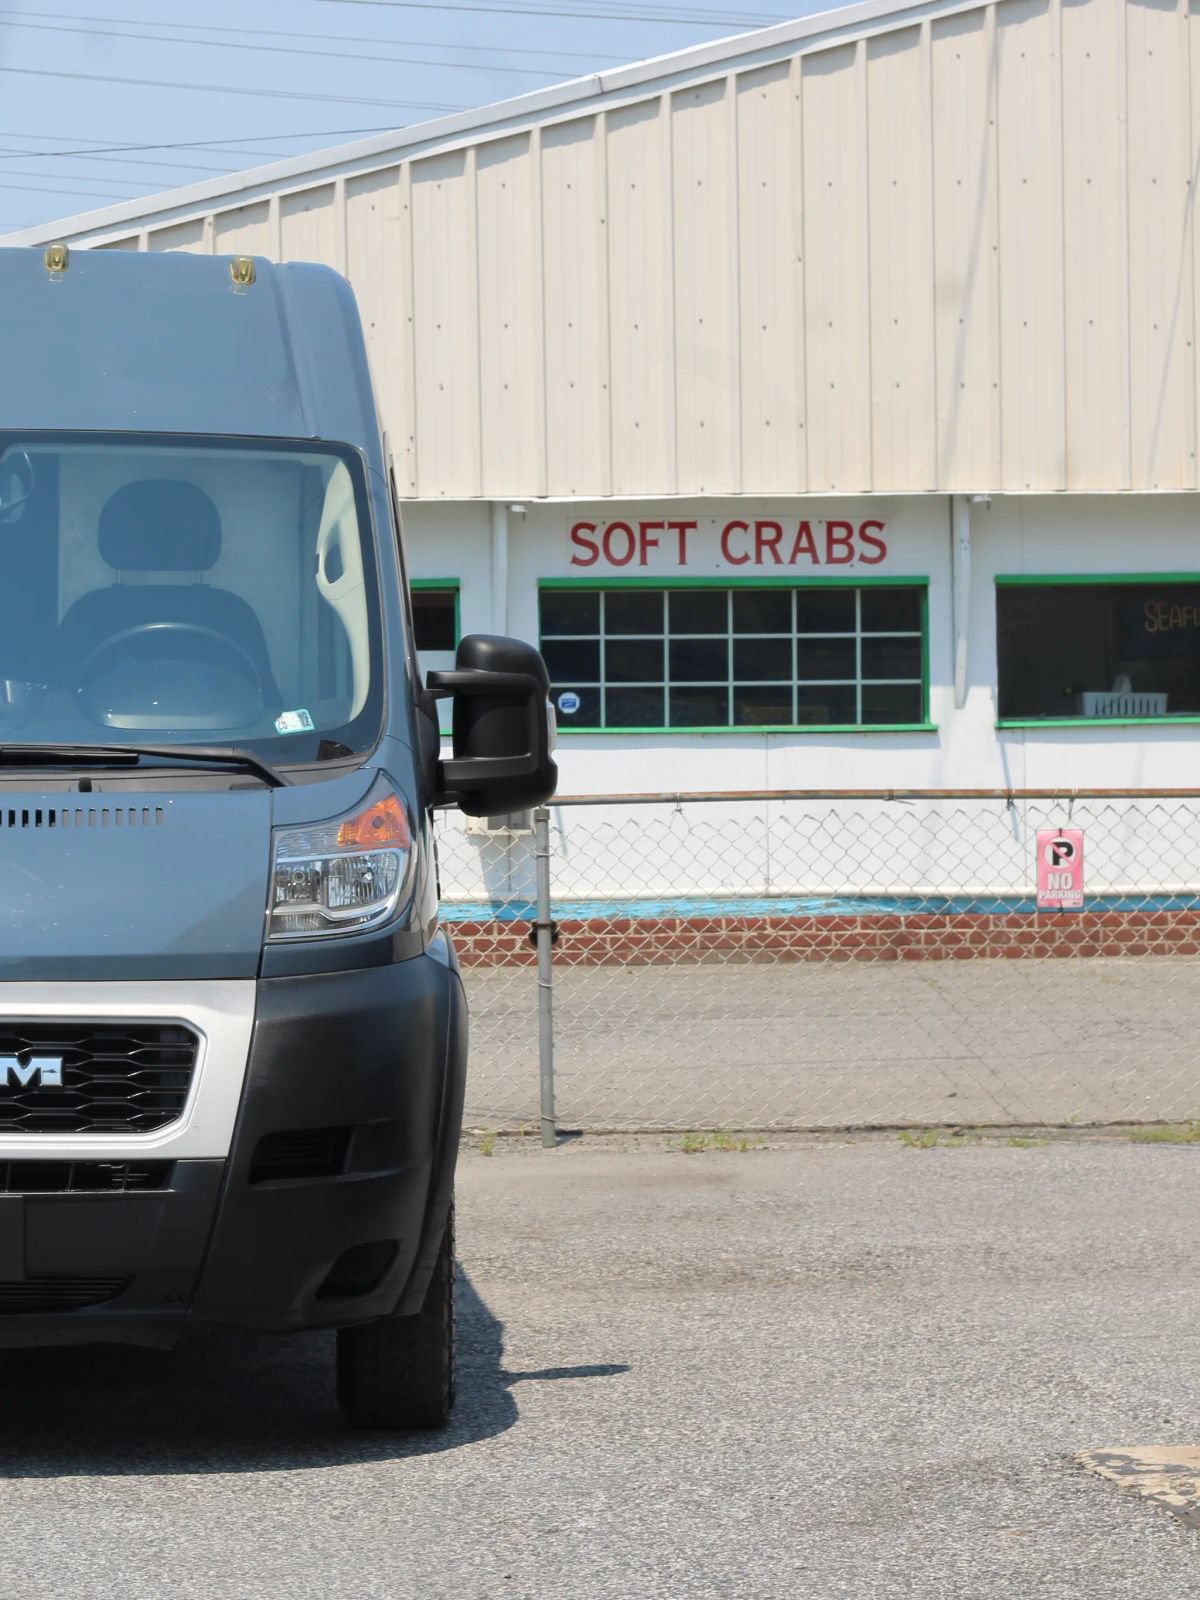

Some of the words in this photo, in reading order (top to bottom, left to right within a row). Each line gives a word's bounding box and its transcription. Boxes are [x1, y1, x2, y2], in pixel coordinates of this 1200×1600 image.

[570, 521, 698, 567] SOFT
[720, 520, 887, 565] CRABS
[1047, 872, 1073, 890] NO
[1039, 889, 1081, 900] PARKING
